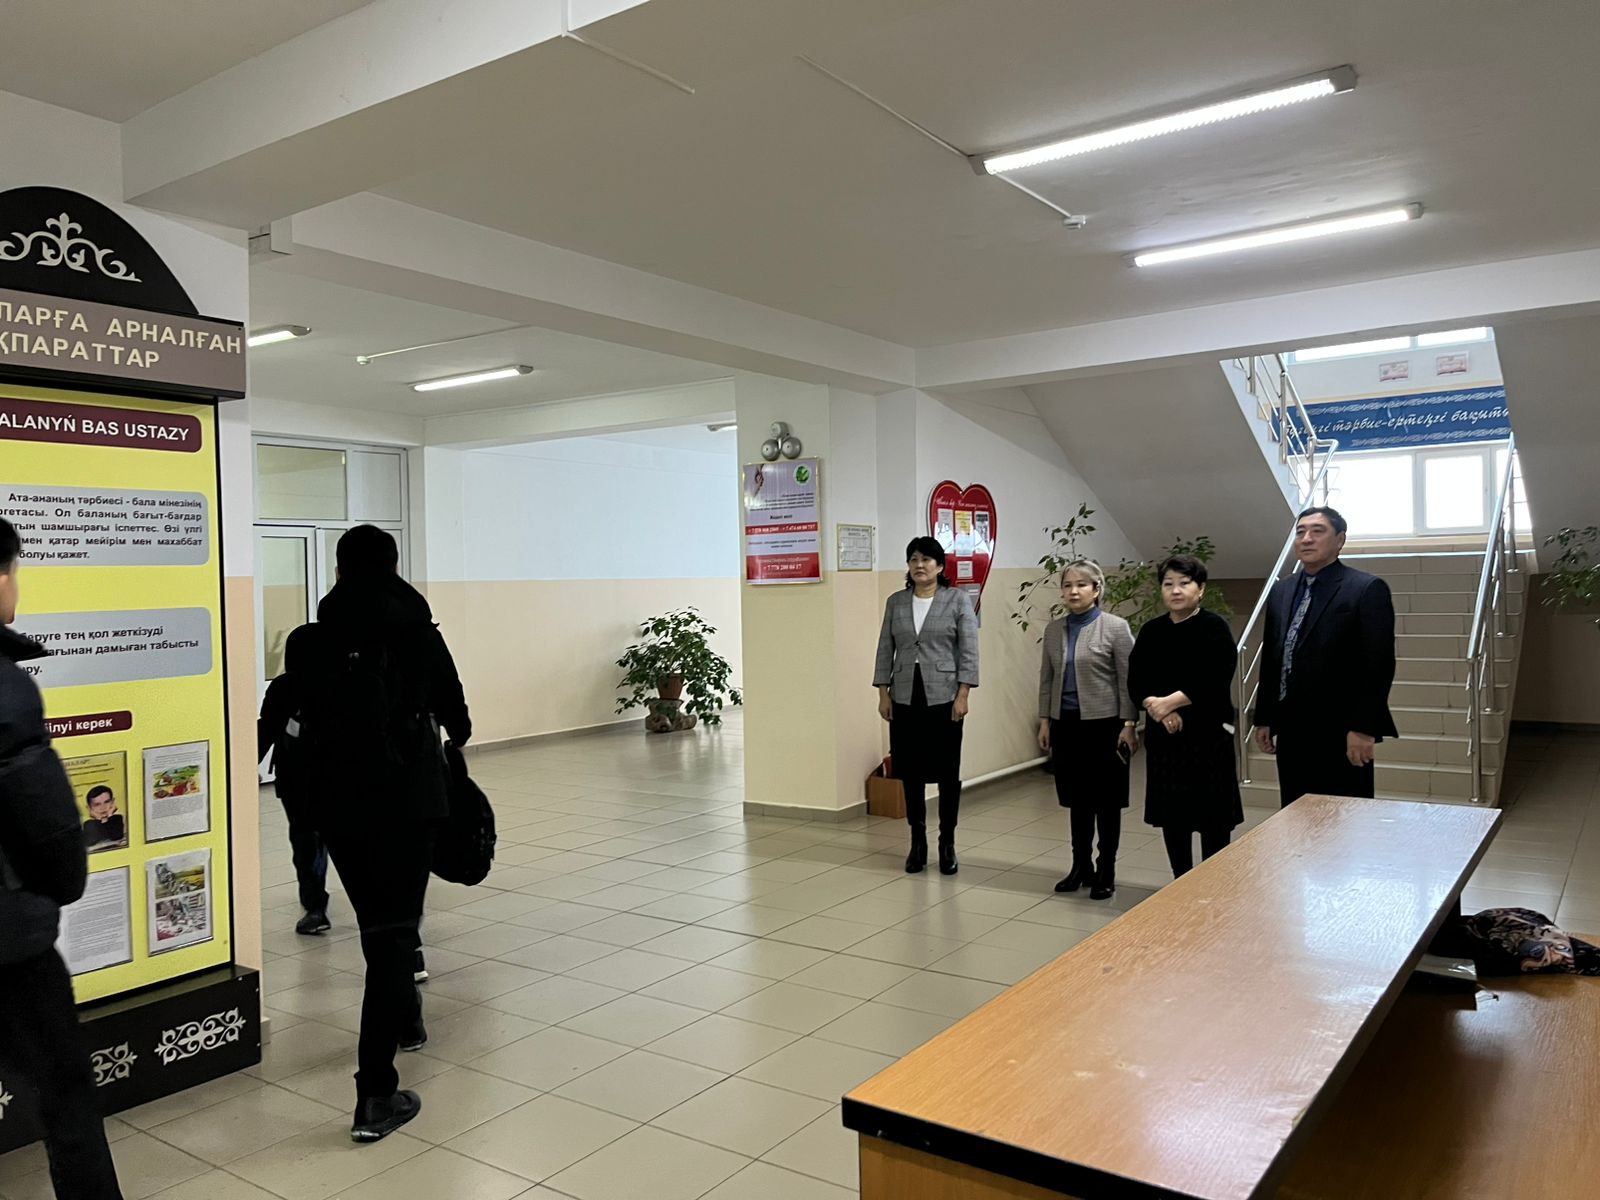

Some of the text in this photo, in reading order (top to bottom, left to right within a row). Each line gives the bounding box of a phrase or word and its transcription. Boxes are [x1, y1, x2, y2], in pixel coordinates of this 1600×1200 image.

[106, 318, 241, 354] АРНАЛҒАН
[82, 420, 119, 435] BAS
[124, 423, 190, 442] USTAZY
[8, 492, 75, 505] Ата-ананың
[132, 497, 156, 507] бала
[158, 499, 202, 509] мінезінің
[55, 508, 71, 518] Ол
[77, 509, 128, 519] баланың
[164, 524, 180, 533] Өзі
[49, 537, 79, 547] қатар
[85, 536, 126, 547] мейірім
[132, 538, 152, 546] мен
[157, 537, 203, 546] махаббат
[64, 632, 86, 642] тең
[88, 630, 109, 640] қол
[112, 626, 164, 640] жеткізуді
[47, 646, 93, 657] ағынан
[150, 639, 199, 651] табысты
[75, 718, 113, 732] керек
